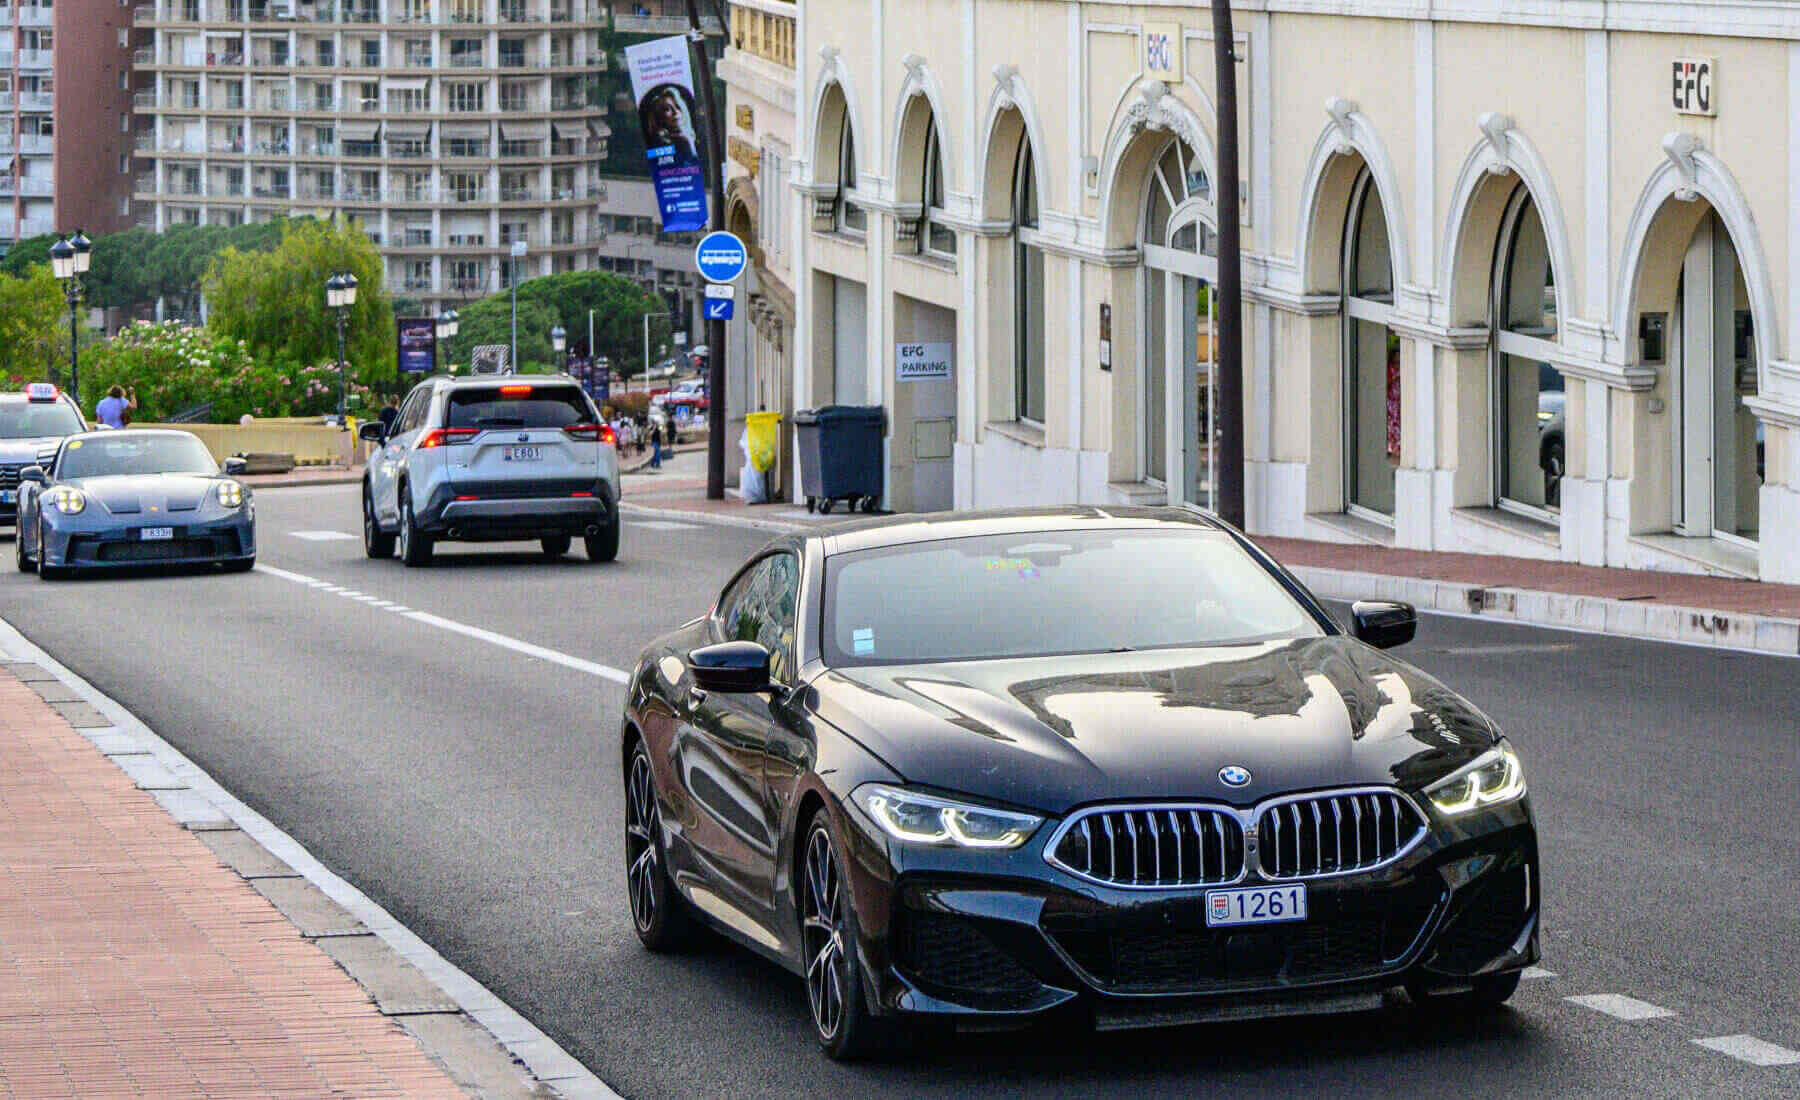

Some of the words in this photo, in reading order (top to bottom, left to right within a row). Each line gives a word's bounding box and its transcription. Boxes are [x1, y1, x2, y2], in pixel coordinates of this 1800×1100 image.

[1672, 61, 1709, 111] EFG
[902, 346, 924, 357] EFG
[902, 361, 947, 372] PARKING
[1237, 889, 1297, 919] 1261
